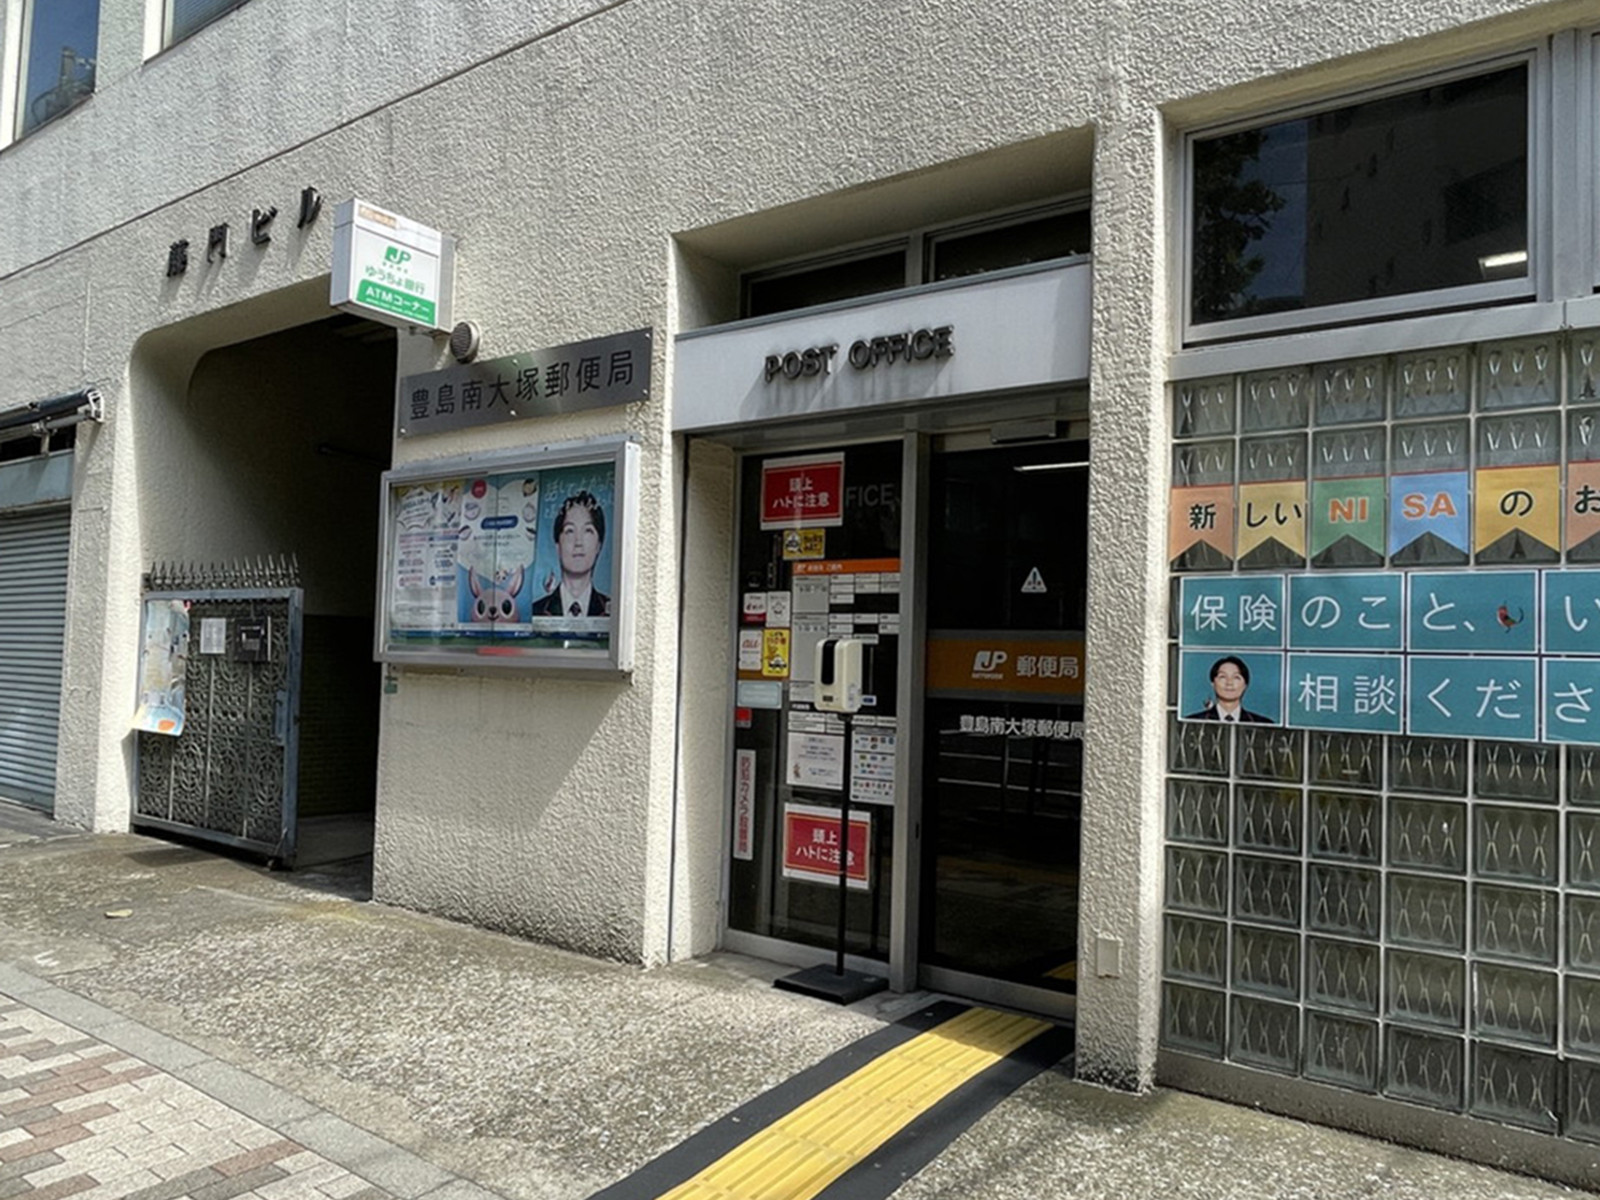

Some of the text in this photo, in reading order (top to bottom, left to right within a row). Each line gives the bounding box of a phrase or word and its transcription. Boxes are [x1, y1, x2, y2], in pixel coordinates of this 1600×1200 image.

[366, 286, 429, 313] ATMコーナー
[765, 324, 956, 384] POST OFFICE
[409, 349, 634, 421] 豊島南大塚郵便局
[772, 492, 830, 509] ハトに注意
[1016, 654, 1079, 679] 郵便局
[1298, 673, 1595, 724] 相談くださ
[959, 714, 1085, 740] 豊島南大塚郵便局
[812, 828, 838, 845] 頭上
